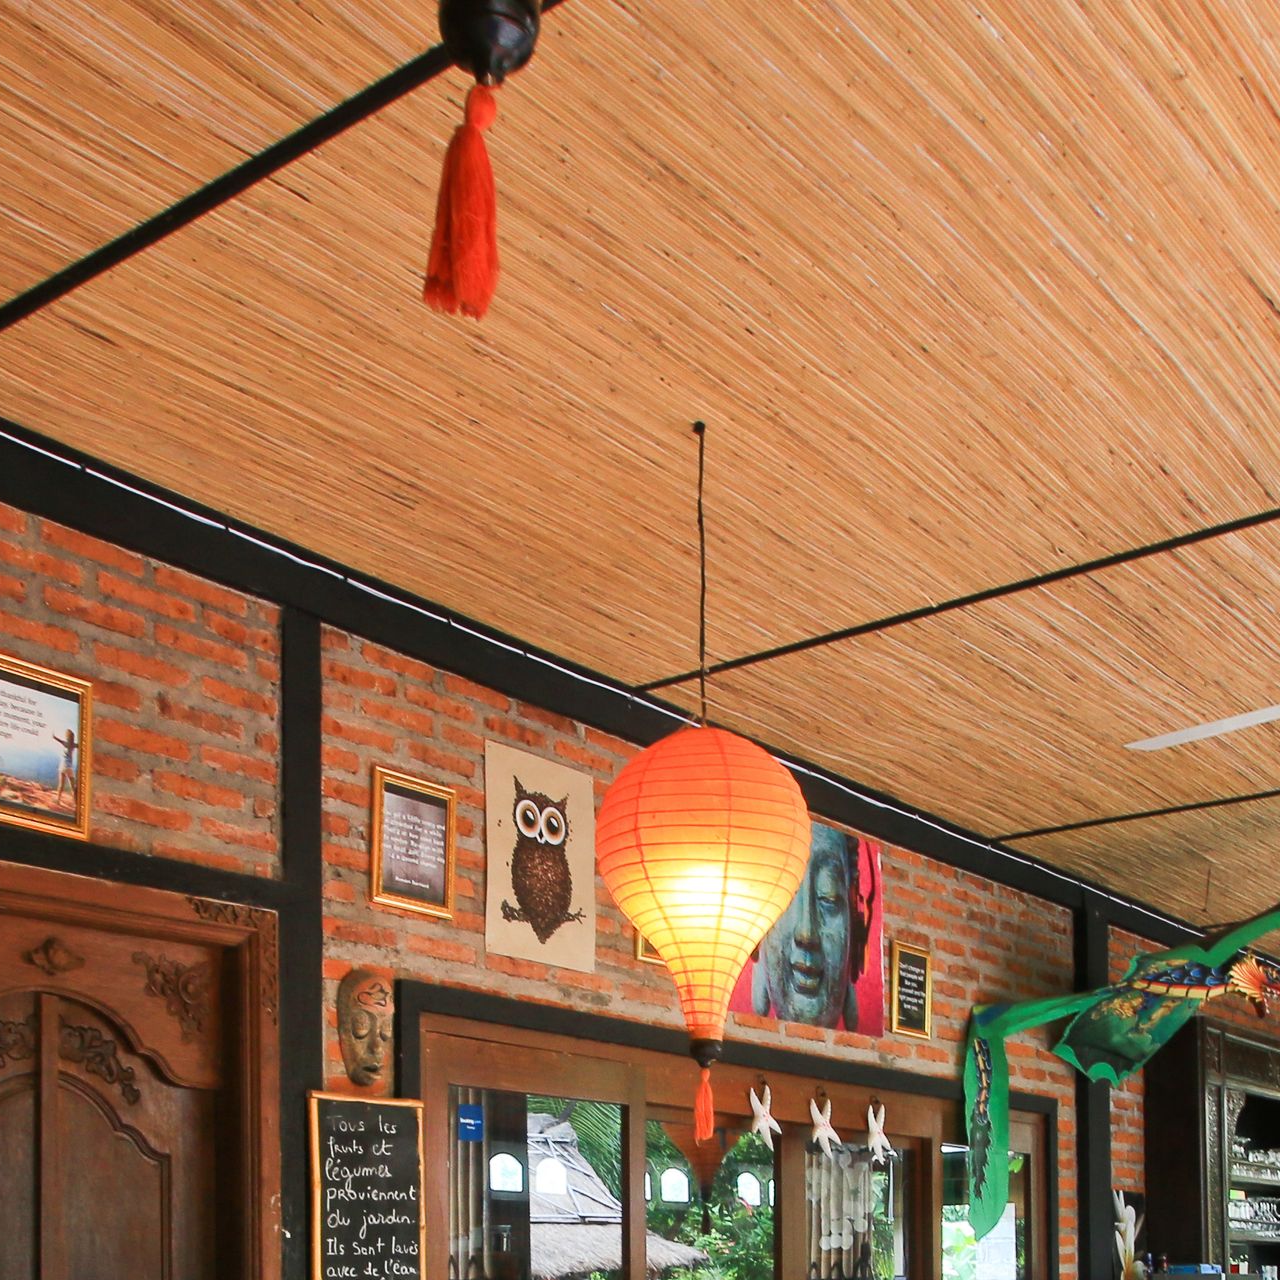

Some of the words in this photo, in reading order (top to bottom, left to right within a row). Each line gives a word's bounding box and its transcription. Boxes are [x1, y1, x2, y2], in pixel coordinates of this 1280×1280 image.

[378, 1114, 397, 1134] les
[372, 1139, 394, 1155] et
[327, 1208, 350, 1228] du
[326, 1237, 345, 1255] Ils
[327, 1266, 358, 1278] avec
[363, 1262, 379, 1276] de
